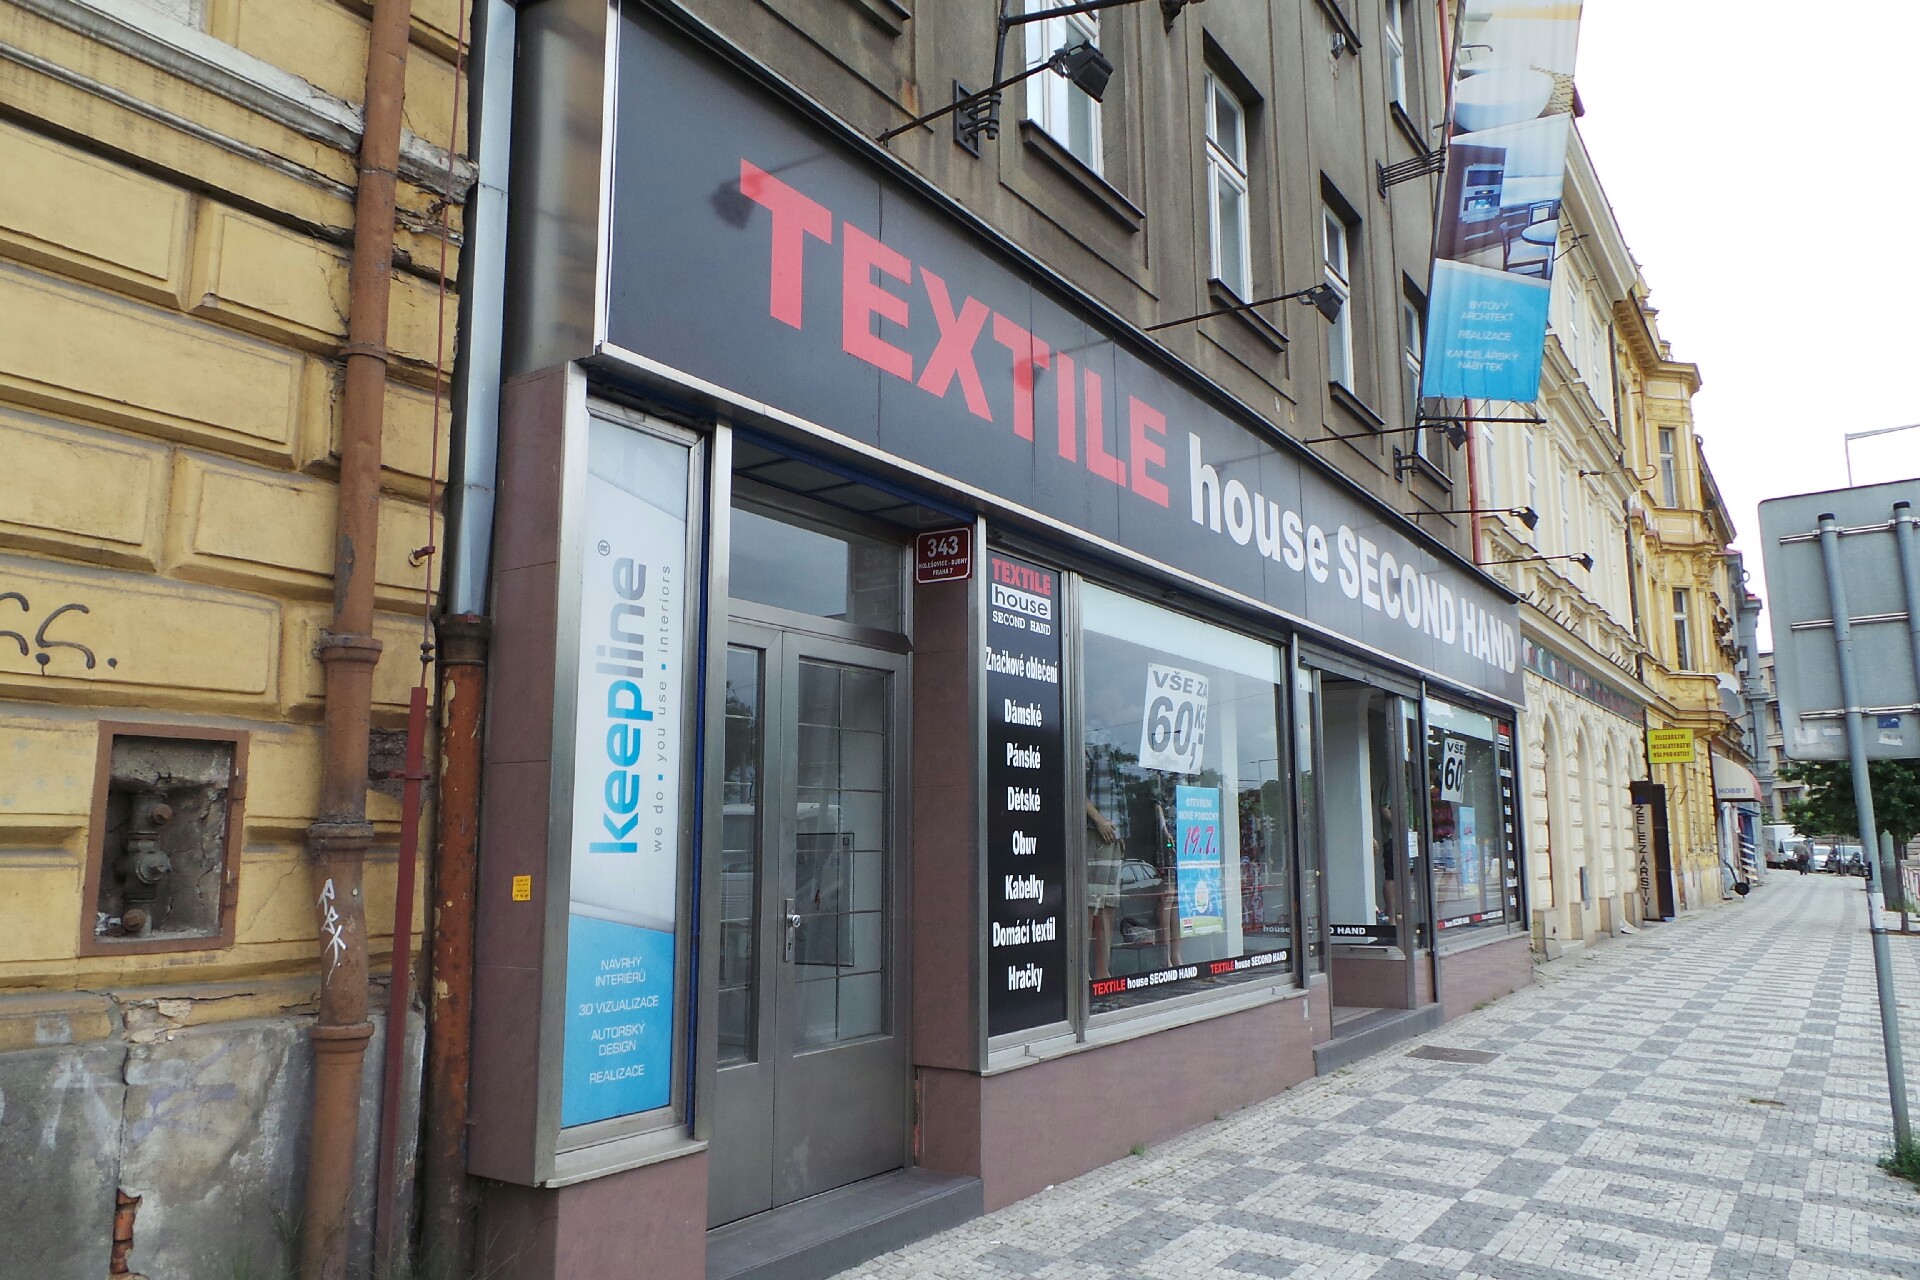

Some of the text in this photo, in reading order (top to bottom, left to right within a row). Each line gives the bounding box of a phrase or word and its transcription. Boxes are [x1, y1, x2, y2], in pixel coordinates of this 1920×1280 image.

[1461, 311, 1514, 322] ARCHITEKT
[1458, 330, 1512, 341] REALIZACE
[740, 158, 1516, 674] TEXTILE house SECOND HAND
[927, 535, 959, 558] 343
[992, 557, 1051, 595] TEXTILE
[995, 586, 1048, 616] house
[992, 611, 1051, 636] SECOND HAND
[985, 647, 1058, 684] Značkové oblečení
[1153, 671, 1208, 699] VŠE ZA
[589, 557, 653, 853] keepline
[653, 566, 670, 852] we do you use interiors
[1004, 698, 1042, 728] Dámské
[1006, 742, 1041, 770] Pánské
[1447, 741, 1464, 755] VŠE
[1007, 786, 1041, 812] Dětské
[1012, 830, 1037, 855] Obuv
[1005, 874, 1044, 904] Kabelky
[993, 917, 1056, 948] Domácí textil
[1337, 926, 1366, 935] HAND
[600, 955, 643, 971] NÁVRHY
[1210, 950, 1287, 974] TEXTILE house SECOND HAND
[595, 969, 646, 987] INTERIÉRŮ
[1008, 962, 1043, 993] Hračky
[1092, 966, 1198, 996] TEXTILE house SECOND HAND
[578, 995, 659, 1016] 3D VIZUALIZACE
[591, 1019, 646, 1041] AUTORSKÝ
[598, 1039, 637, 1056] DESIGN
[590, 1064, 645, 1084] REALIZACE
